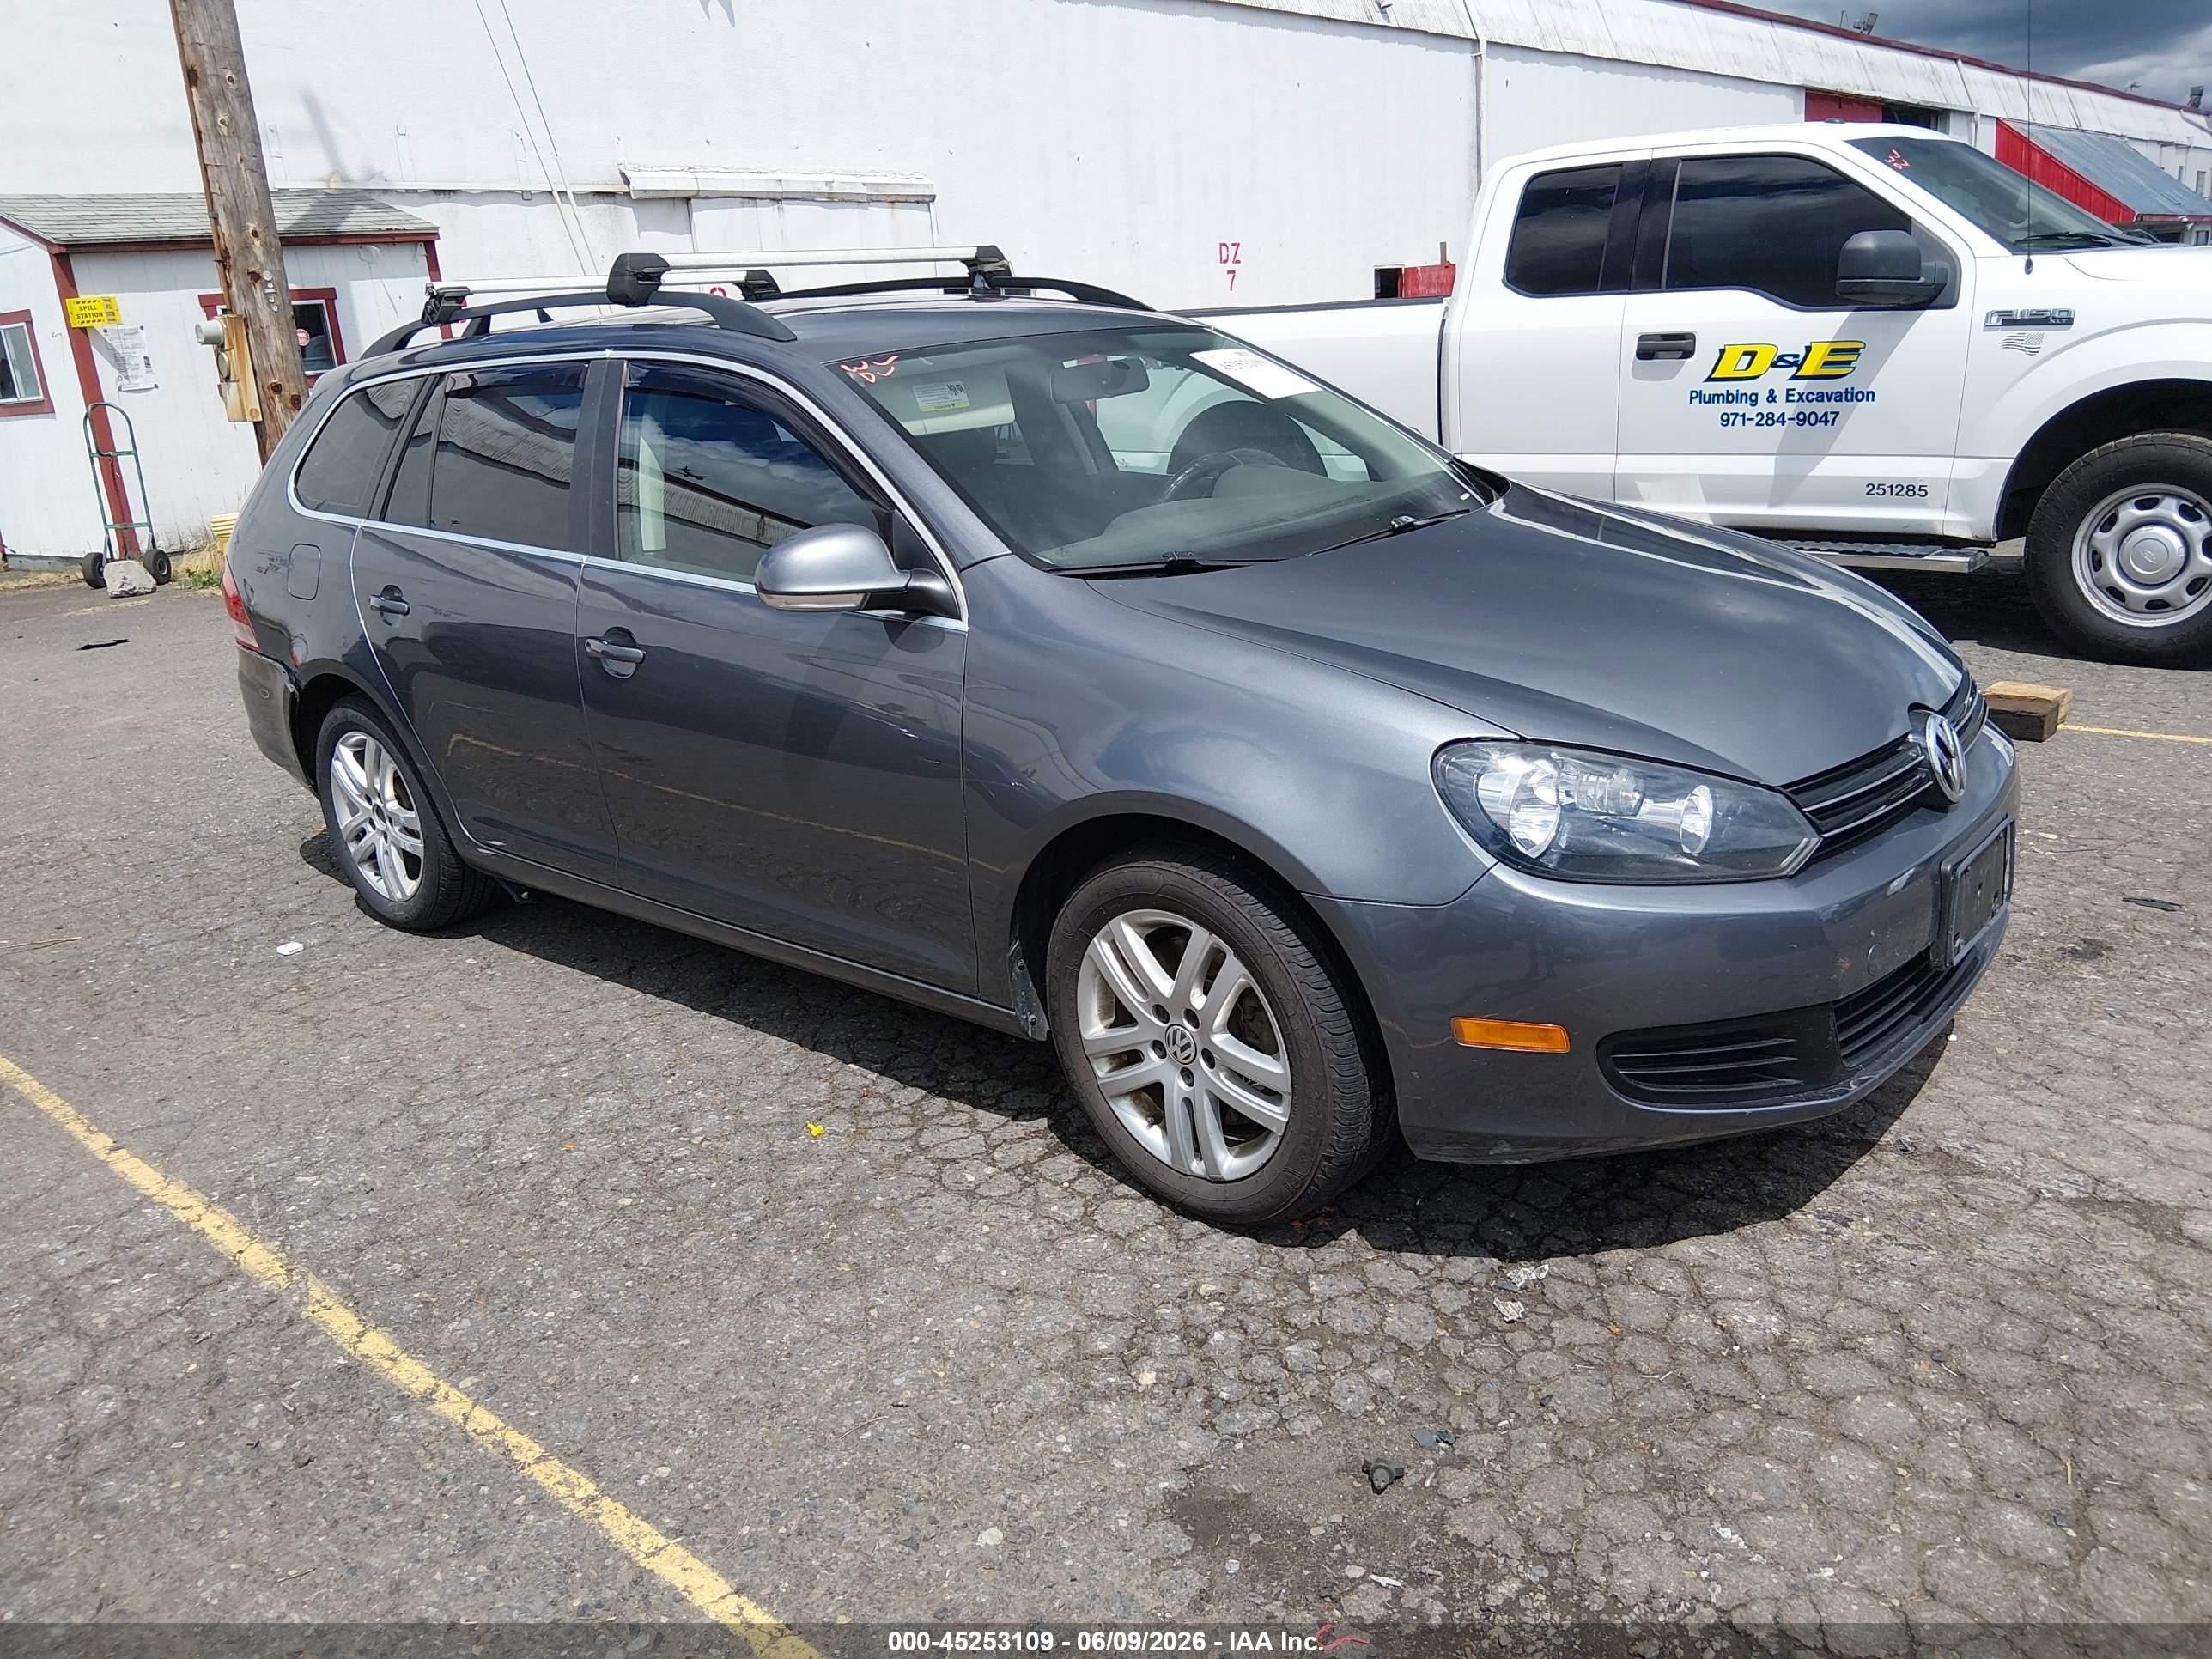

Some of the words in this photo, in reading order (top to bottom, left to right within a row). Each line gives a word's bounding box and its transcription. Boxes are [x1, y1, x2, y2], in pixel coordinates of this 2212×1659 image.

[1219, 242, 1242, 264] DZ
[1226, 270, 1237, 292] 7
[1702, 340, 1867, 383] D&E
[1689, 389, 1759, 406] Plumbing
[1765, 388, 1778, 404] &
[1785, 387, 1875, 403] Excavation
[1720, 410, 1841, 428] 971-284-9047
[1865, 483, 1929, 498] 251285
